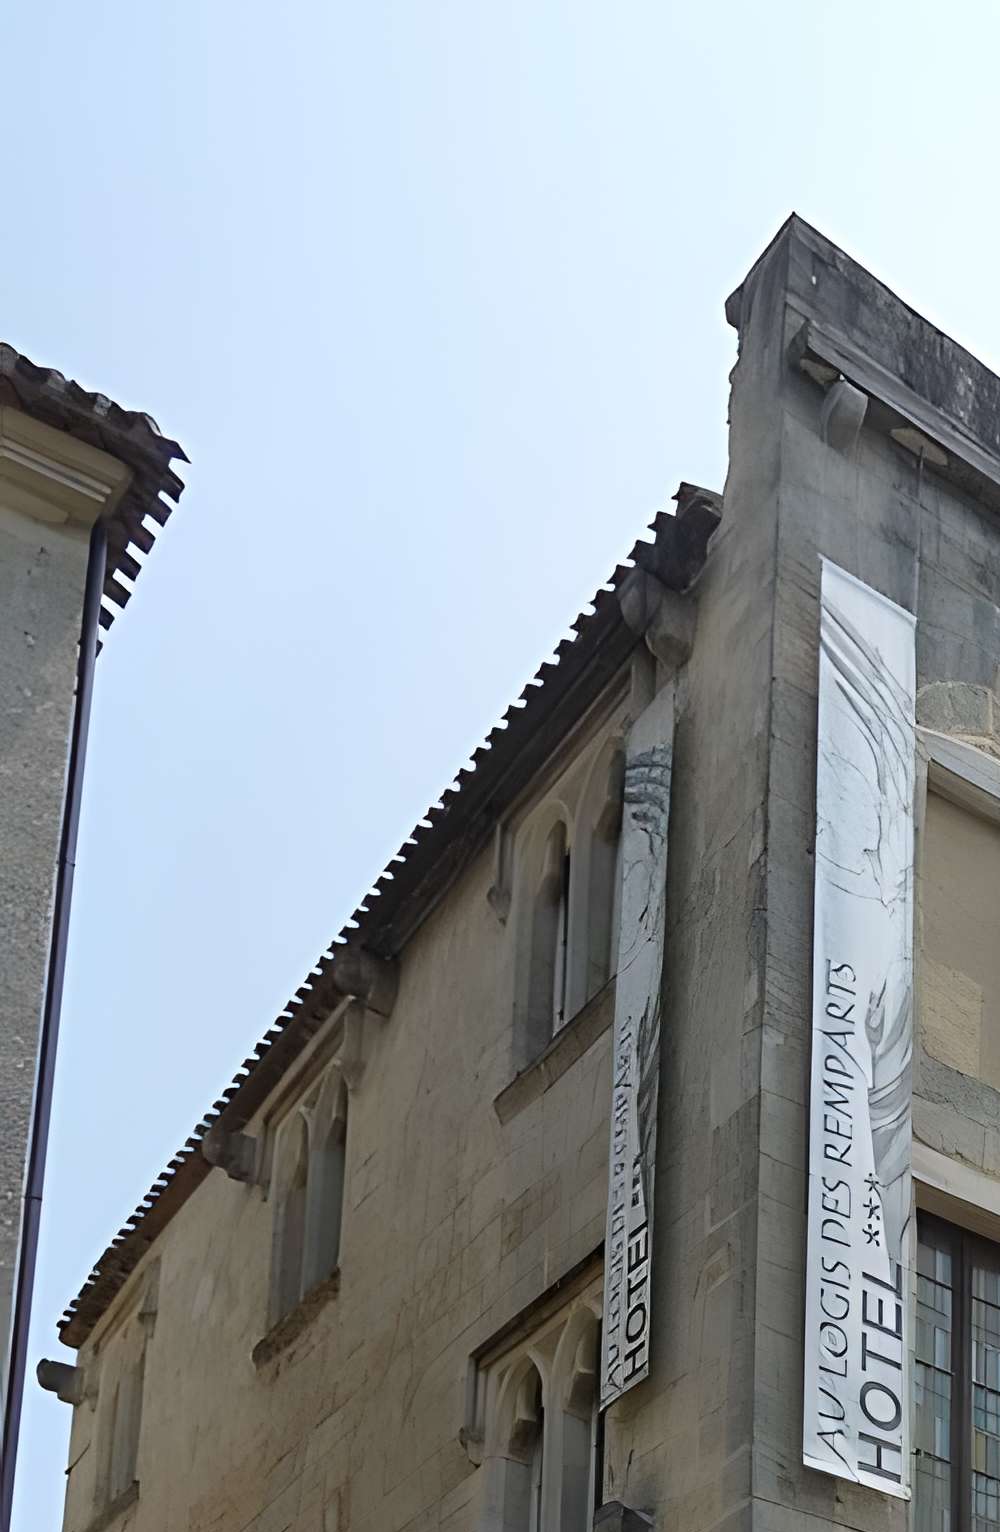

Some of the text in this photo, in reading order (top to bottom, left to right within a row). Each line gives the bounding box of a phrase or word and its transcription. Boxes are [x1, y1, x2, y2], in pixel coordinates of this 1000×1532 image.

[623, 1218, 649, 1383] HOTEL
[817, 958, 862, 1483] AU LOGIS DES REMPARTS
[857, 1263, 902, 1485] HOTEL
